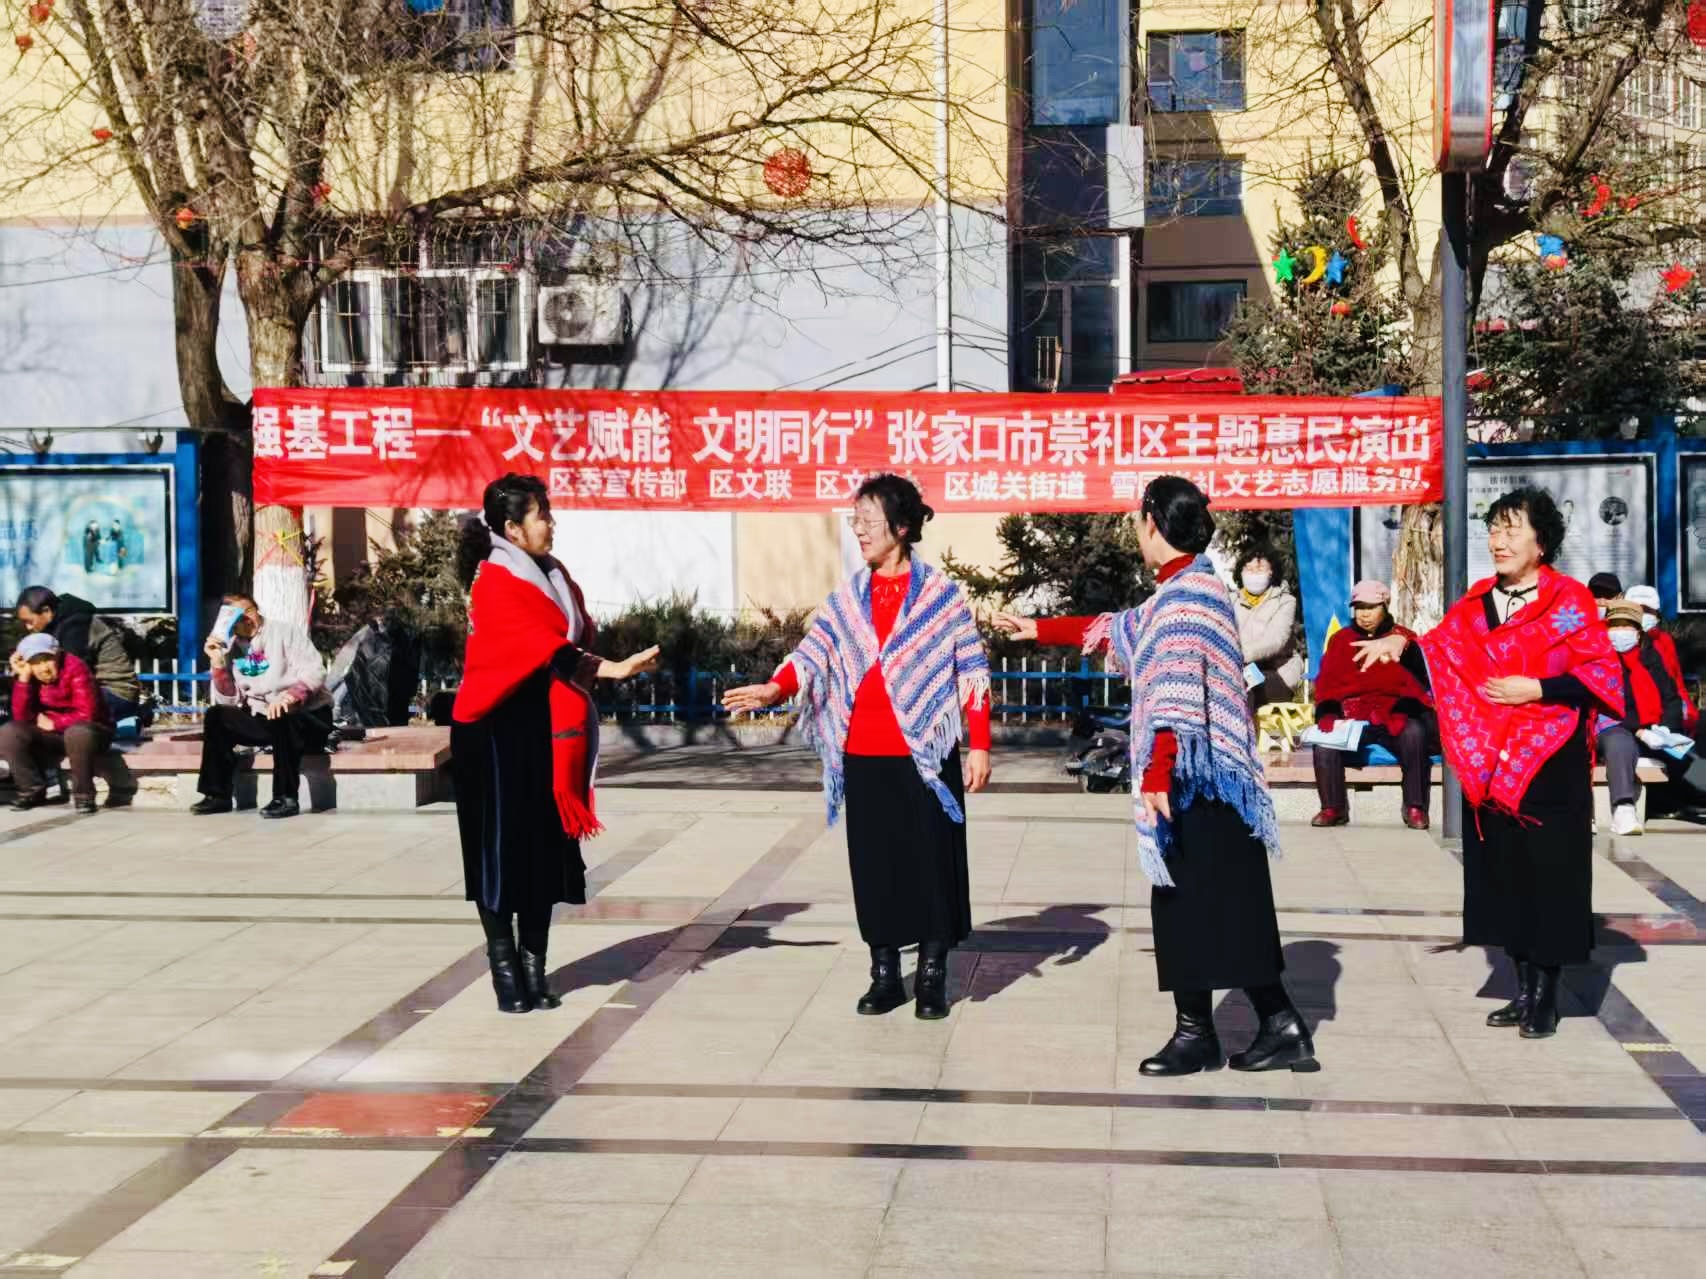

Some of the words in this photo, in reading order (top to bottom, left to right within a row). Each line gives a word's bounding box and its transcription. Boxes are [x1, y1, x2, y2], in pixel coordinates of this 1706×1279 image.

[886, 408, 1431, 466] 张家口市崇礼区主题惠民演出
[549, 466, 687, 499] 区委宣传部
[709, 468, 792, 500] 区文联
[944, 469, 1087, 501] 区城关街道
[1110, 465, 1431, 499] 雪礼文艺志愿服务队
